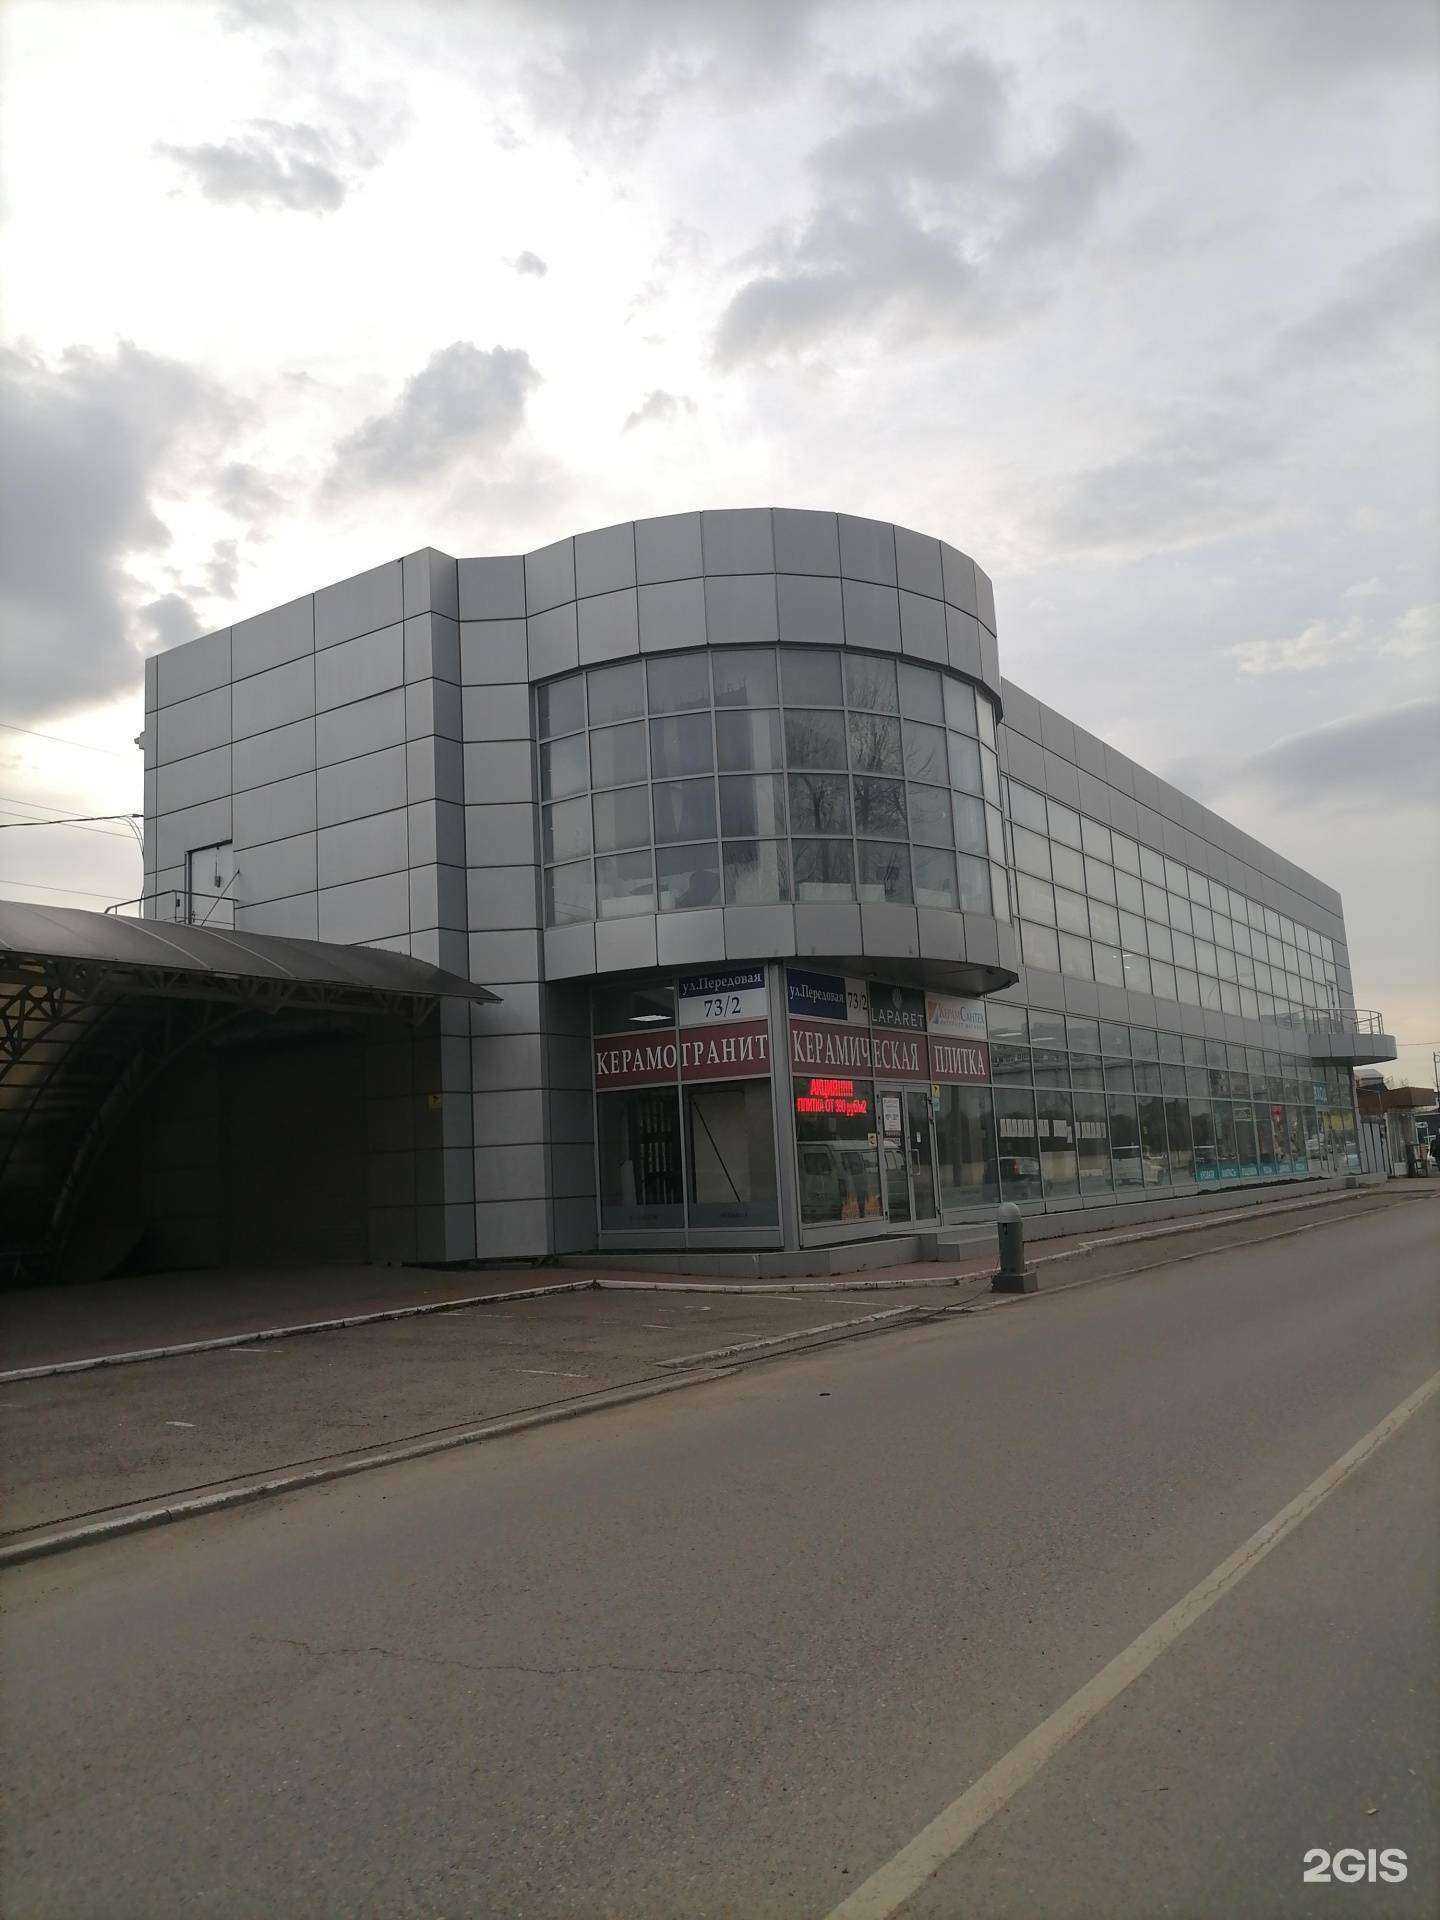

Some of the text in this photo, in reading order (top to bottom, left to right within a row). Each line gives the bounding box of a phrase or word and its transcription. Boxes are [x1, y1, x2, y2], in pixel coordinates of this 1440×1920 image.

[704, 996, 742, 1018] 73/2
[848, 991, 868, 1011] 73/2
[871, 1007, 924, 1028] LAPARET
[595, 1034, 768, 1075] КЕРАМОГРАНИТ
[793, 1030, 986, 1076] КЕРАМИЧЕСКАЯ ПЛИТКА
